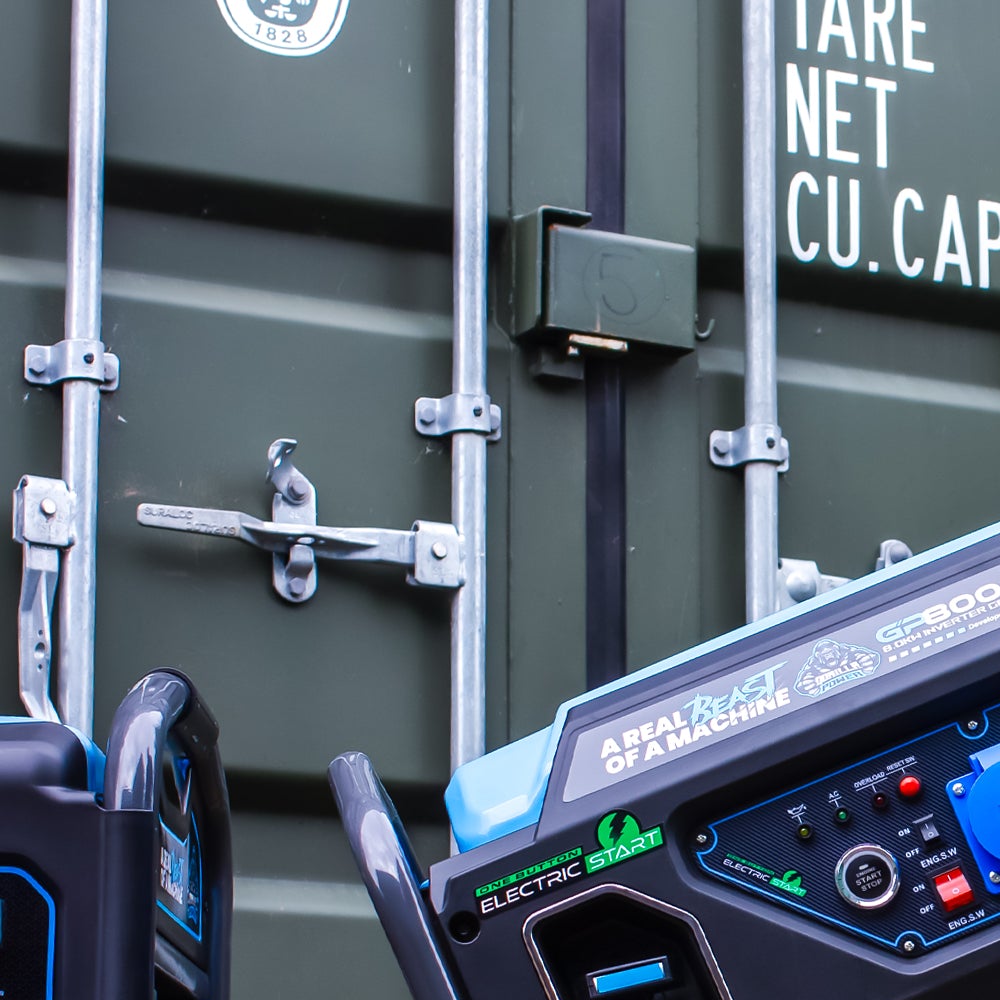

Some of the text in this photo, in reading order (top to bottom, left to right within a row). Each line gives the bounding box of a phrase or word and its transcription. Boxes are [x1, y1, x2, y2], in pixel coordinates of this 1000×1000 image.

[256, 23, 308, 44] 1828
[786, 62, 898, 168] NET
[924, 606, 987, 636] INVERTER
[822, 670, 864, 692] POWER
[600, 660, 789, 759] A REAL BEAST
[605, 687, 791, 774] OF A MACHINE
[854, 771, 885, 788] OVERLOAD
[828, 790, 840, 800] AC
[898, 828, 911, 836] ON
[589, 830, 658, 870] START
[906, 847, 920, 858] OFF
[920, 846, 957, 868] ENG.S.W
[480, 849, 580, 894] ONE BUTTON
[722, 858, 771, 882] ELECTRIC
[772, 878, 806, 896] START
[856, 870, 882, 886] START
[480, 862, 582, 914] ELECTRIC
[861, 878, 882, 892] STOP
[912, 884, 925, 893] ON
[920, 903, 935, 914] OFF
[948, 909, 986, 930] ENG.S.W
